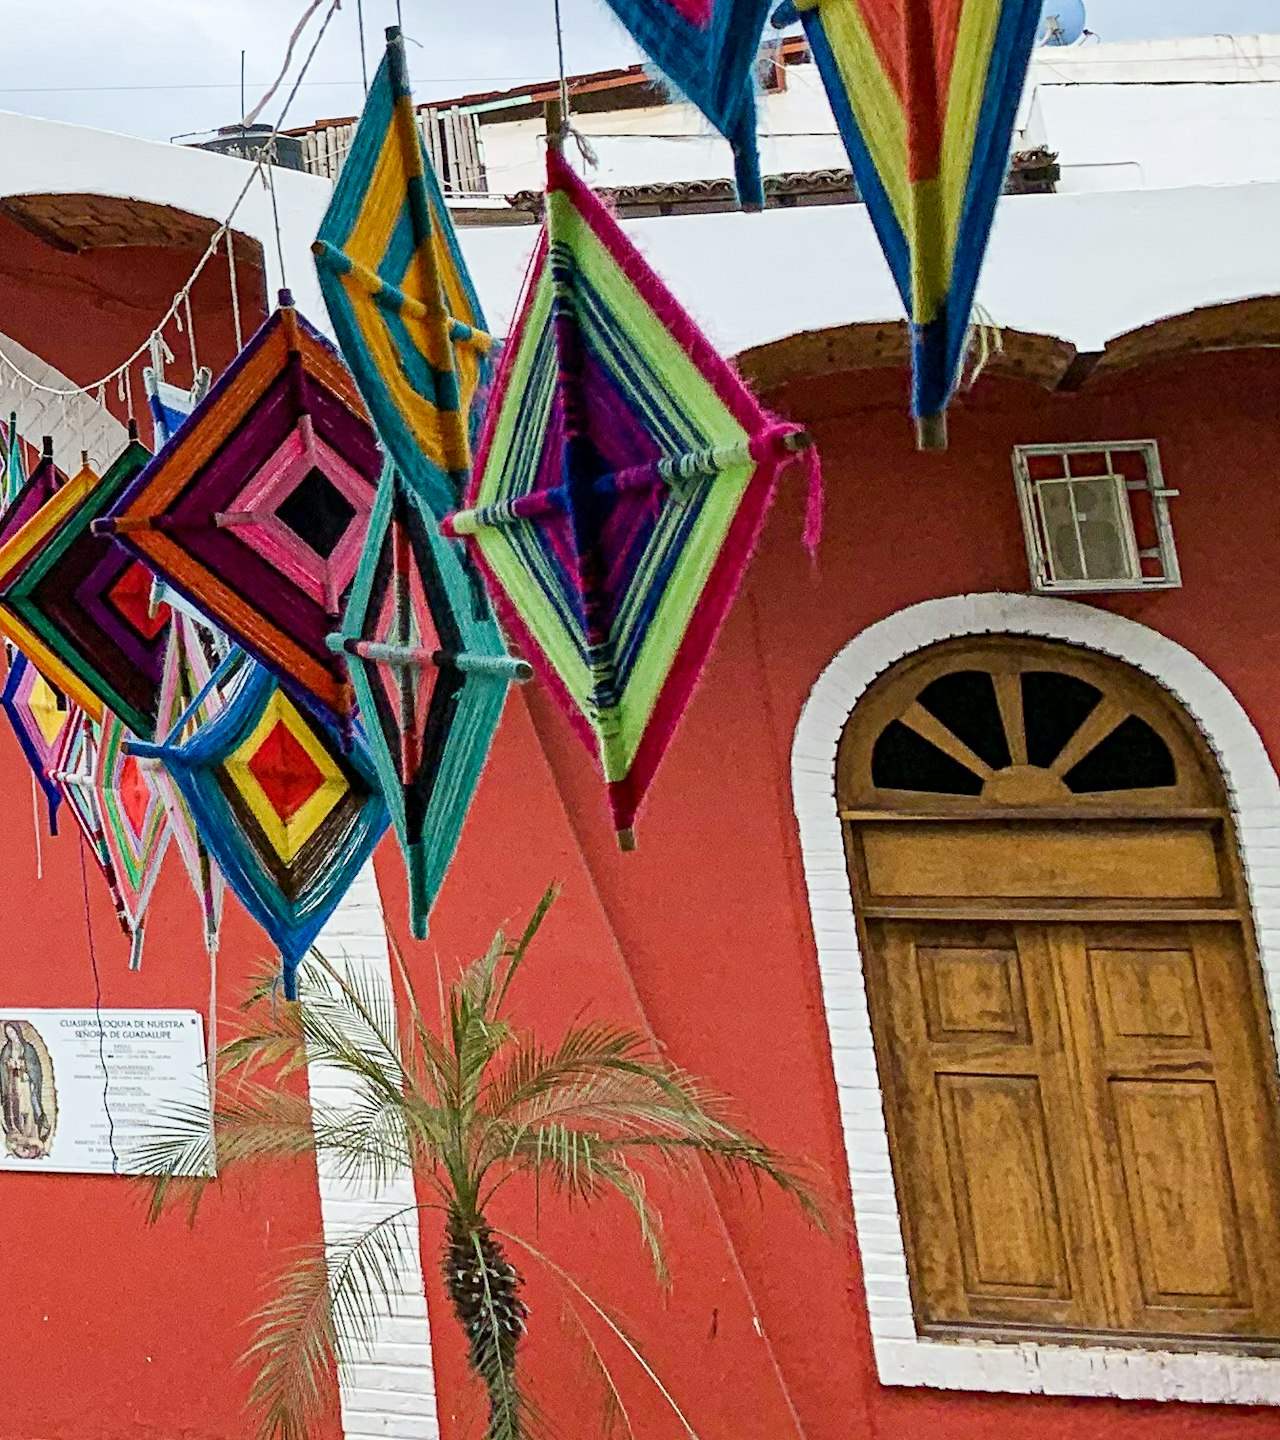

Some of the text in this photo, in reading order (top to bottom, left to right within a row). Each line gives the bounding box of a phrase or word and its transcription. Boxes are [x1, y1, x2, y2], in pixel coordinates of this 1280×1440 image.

[60, 1019, 185, 1029] CUASIPAROQUIA DE NUESTRA
[110, 1030, 120, 1038] DE
[122, 1031, 171, 1039] GUADALUPE
